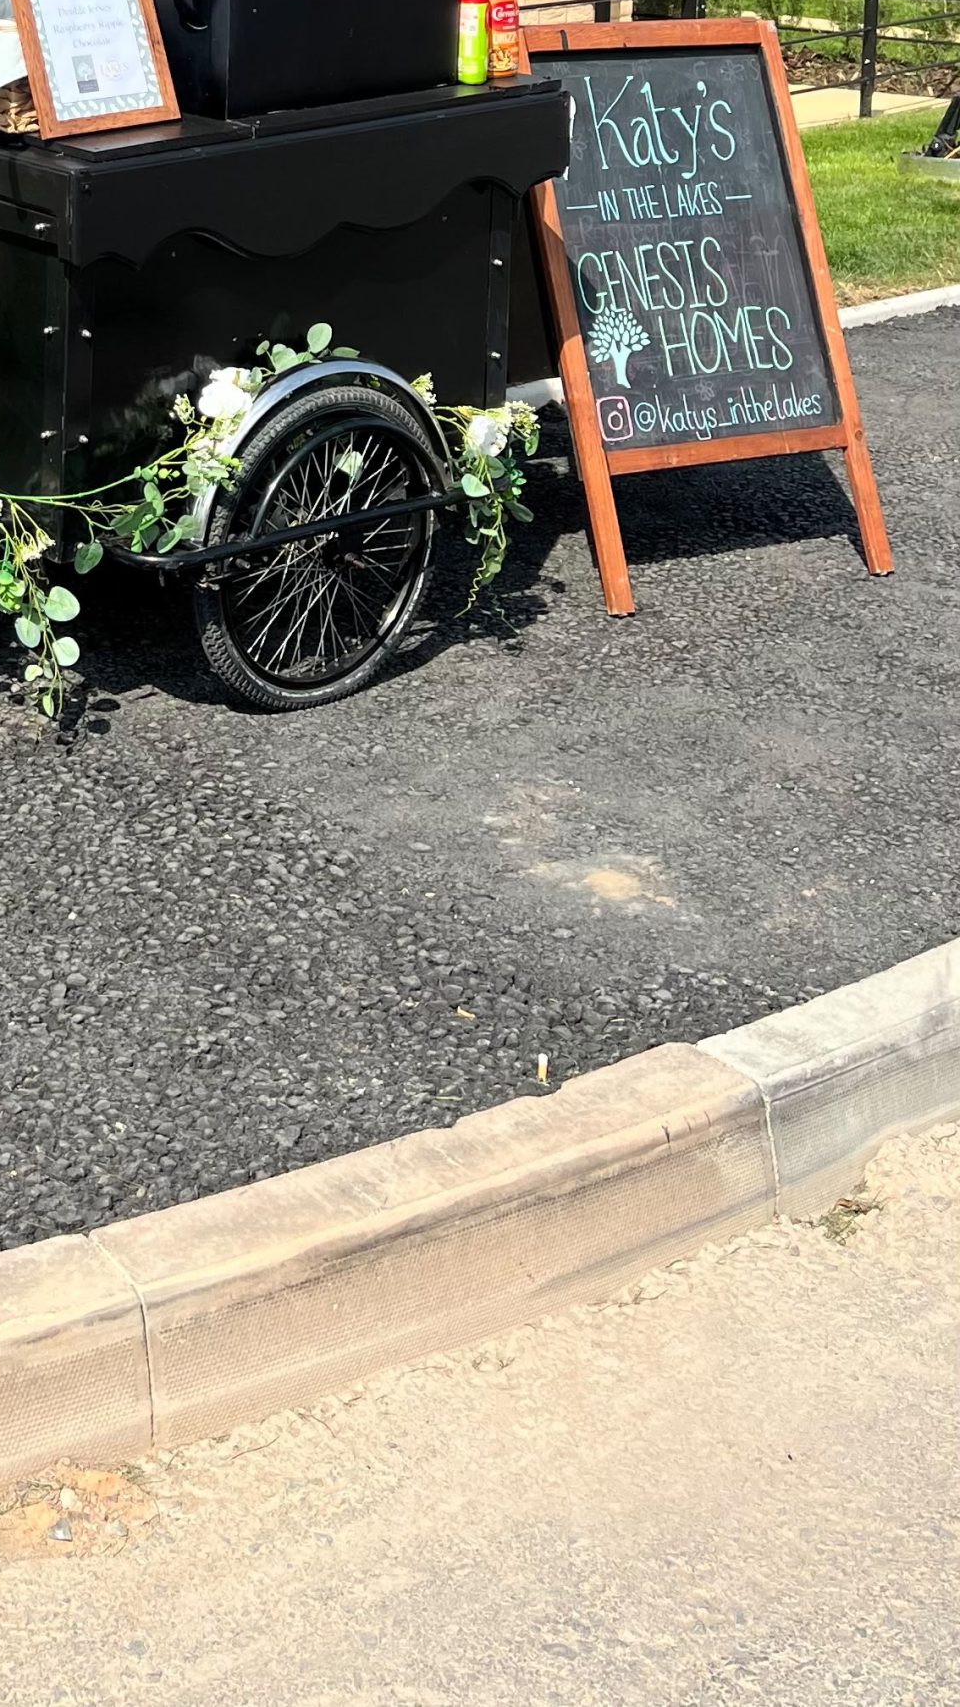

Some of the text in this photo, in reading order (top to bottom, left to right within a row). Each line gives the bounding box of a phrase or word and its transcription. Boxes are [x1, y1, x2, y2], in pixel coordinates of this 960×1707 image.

[583, 75, 736, 179] Katy's
[597, 181, 724, 222] IN THE LAKES
[577, 236, 728, 314] GENESIS
[658, 306, 793, 377] HOMES
[633, 381, 822, 441] @katys_inthelakes
